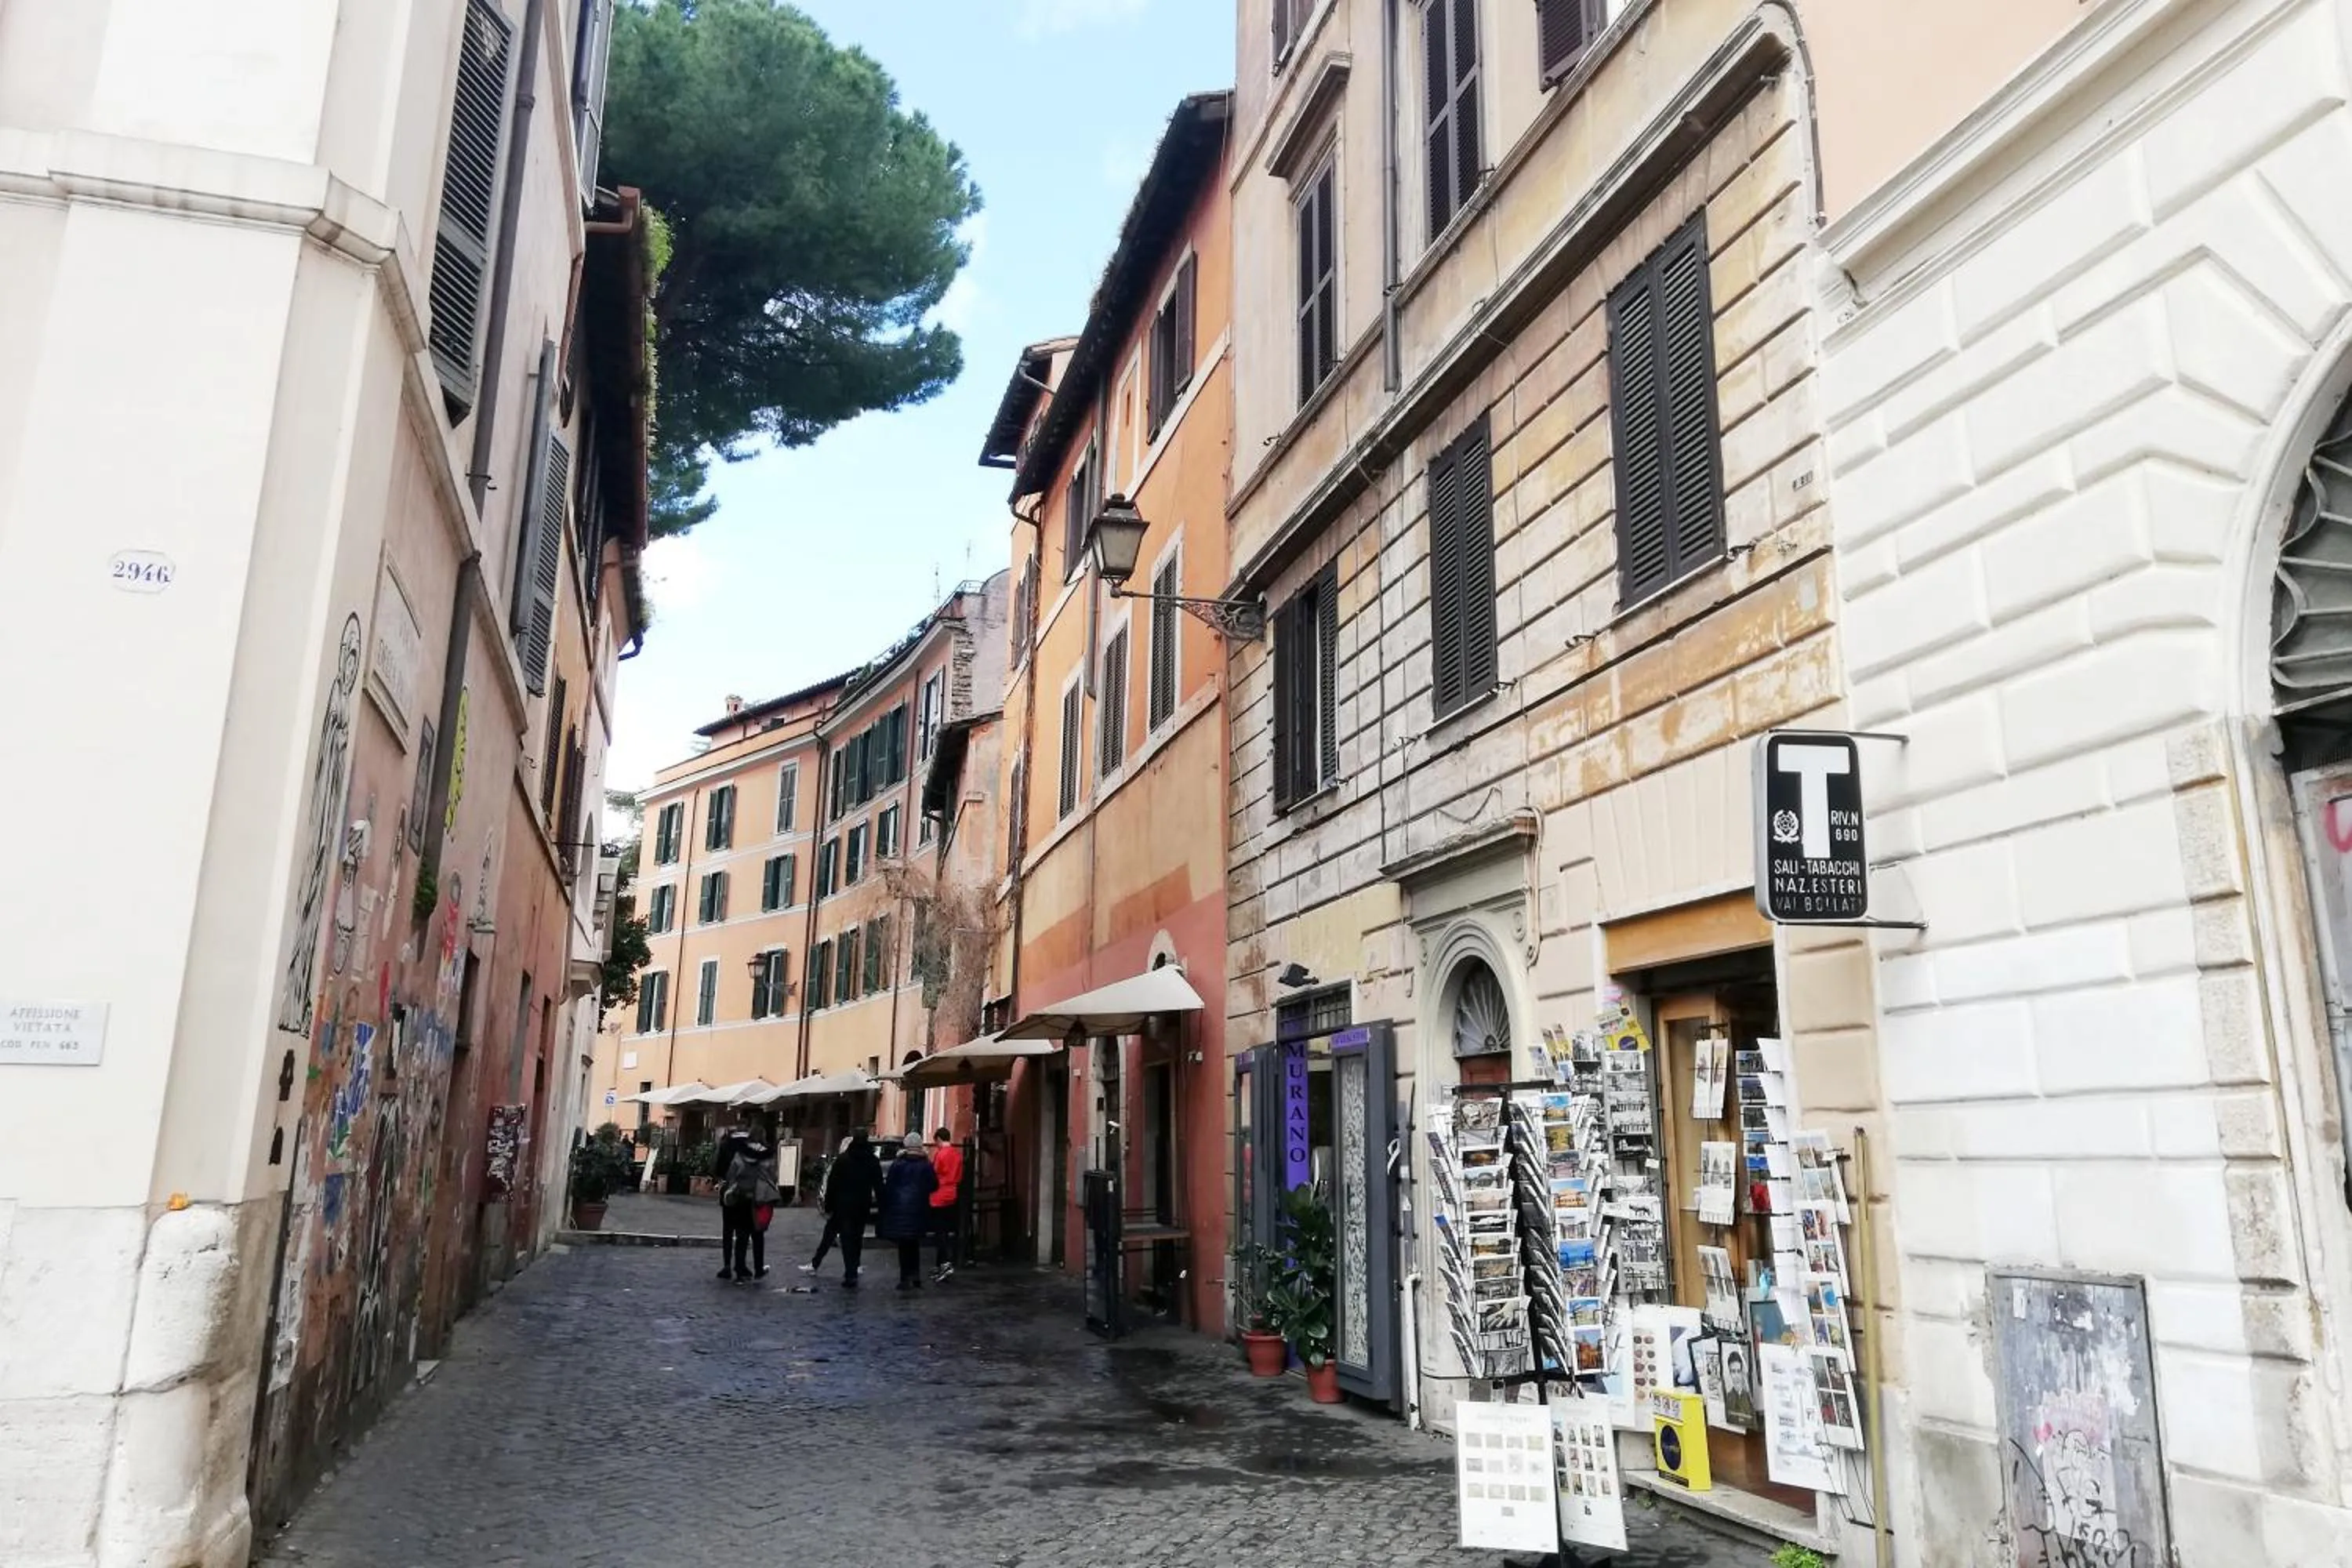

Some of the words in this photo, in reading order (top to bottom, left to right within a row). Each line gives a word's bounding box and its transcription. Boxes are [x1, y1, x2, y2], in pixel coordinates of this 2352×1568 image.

[112, 560, 171, 583] 2946
[1777, 744, 1850, 858] T
[1835, 829, 1858, 841] 690
[1287, 1043, 1306, 1163] MURANO
